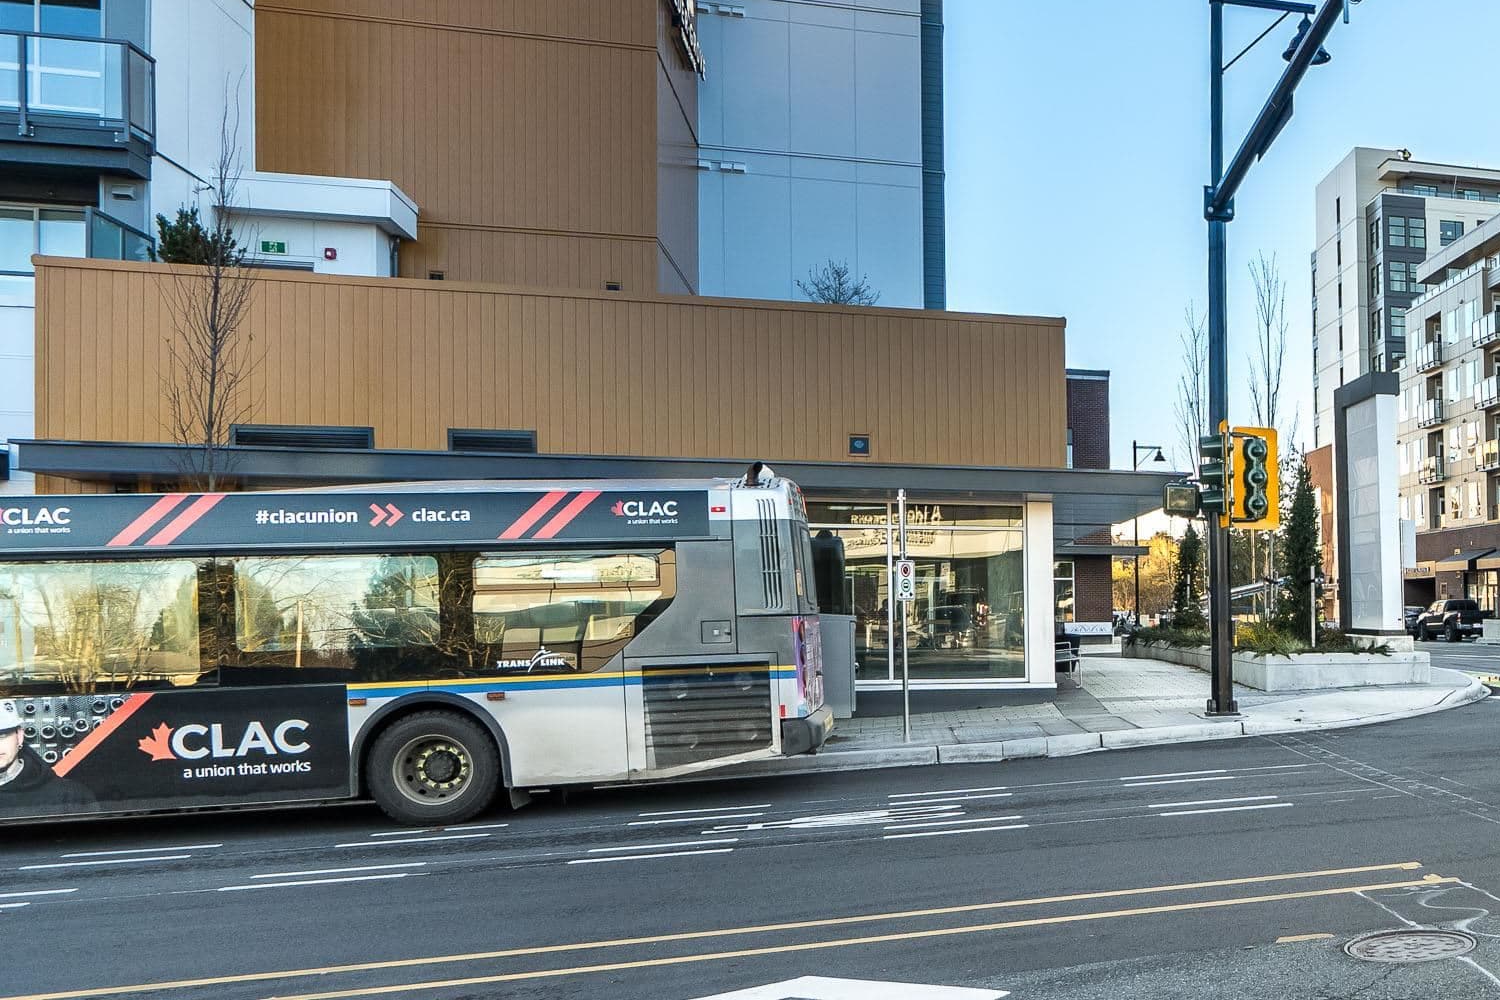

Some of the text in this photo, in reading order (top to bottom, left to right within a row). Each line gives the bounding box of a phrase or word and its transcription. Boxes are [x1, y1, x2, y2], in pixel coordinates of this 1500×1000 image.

[2, 507, 71, 526] CLAC
[255, 507, 471, 524] #clacunion clac.ca
[622, 500, 679, 517] CLAC
[49, 526, 71, 534] works
[496, 660, 531, 669] TRANS
[540, 658, 566, 667] LINK
[171, 719, 311, 760] CLAC
[183, 760, 312, 779] a union that works
